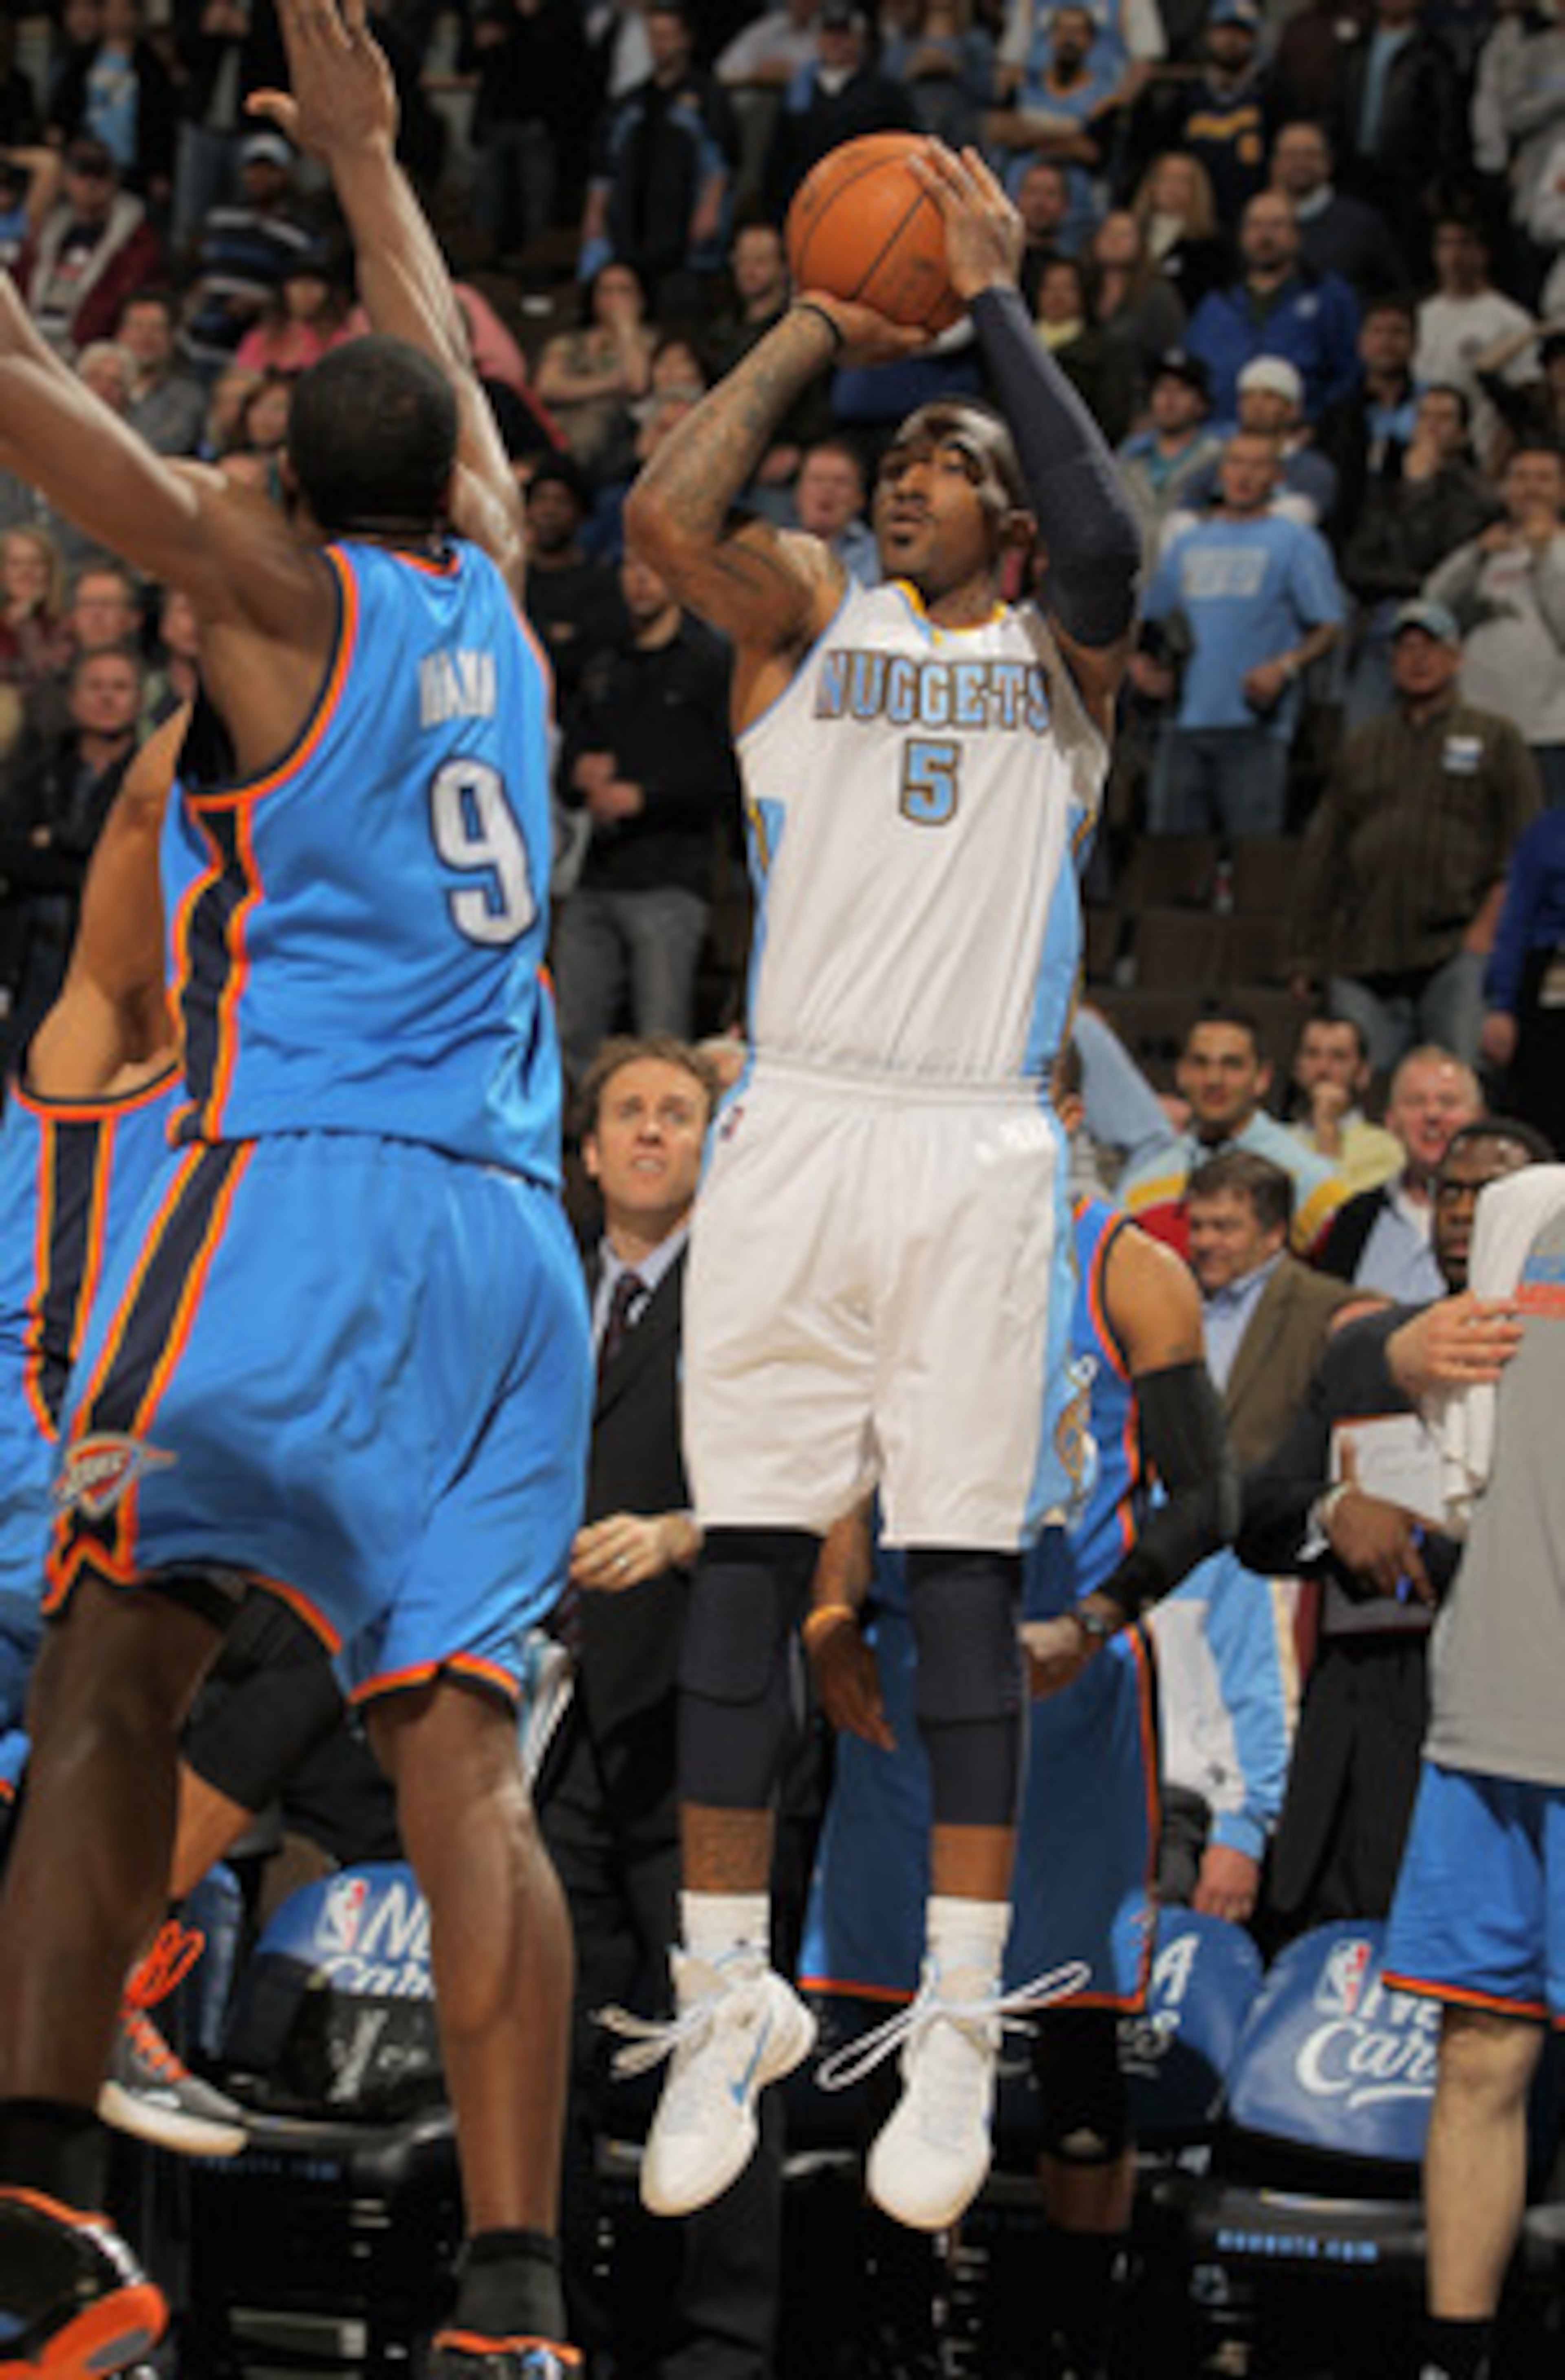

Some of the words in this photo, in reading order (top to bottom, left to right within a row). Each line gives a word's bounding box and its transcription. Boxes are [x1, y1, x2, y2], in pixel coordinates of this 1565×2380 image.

[813, 650, 1051, 736] NUGGETS
[899, 738, 963, 826] 5
[430, 757, 540, 949] 9
[1296, 2020, 1438, 2097] Car
